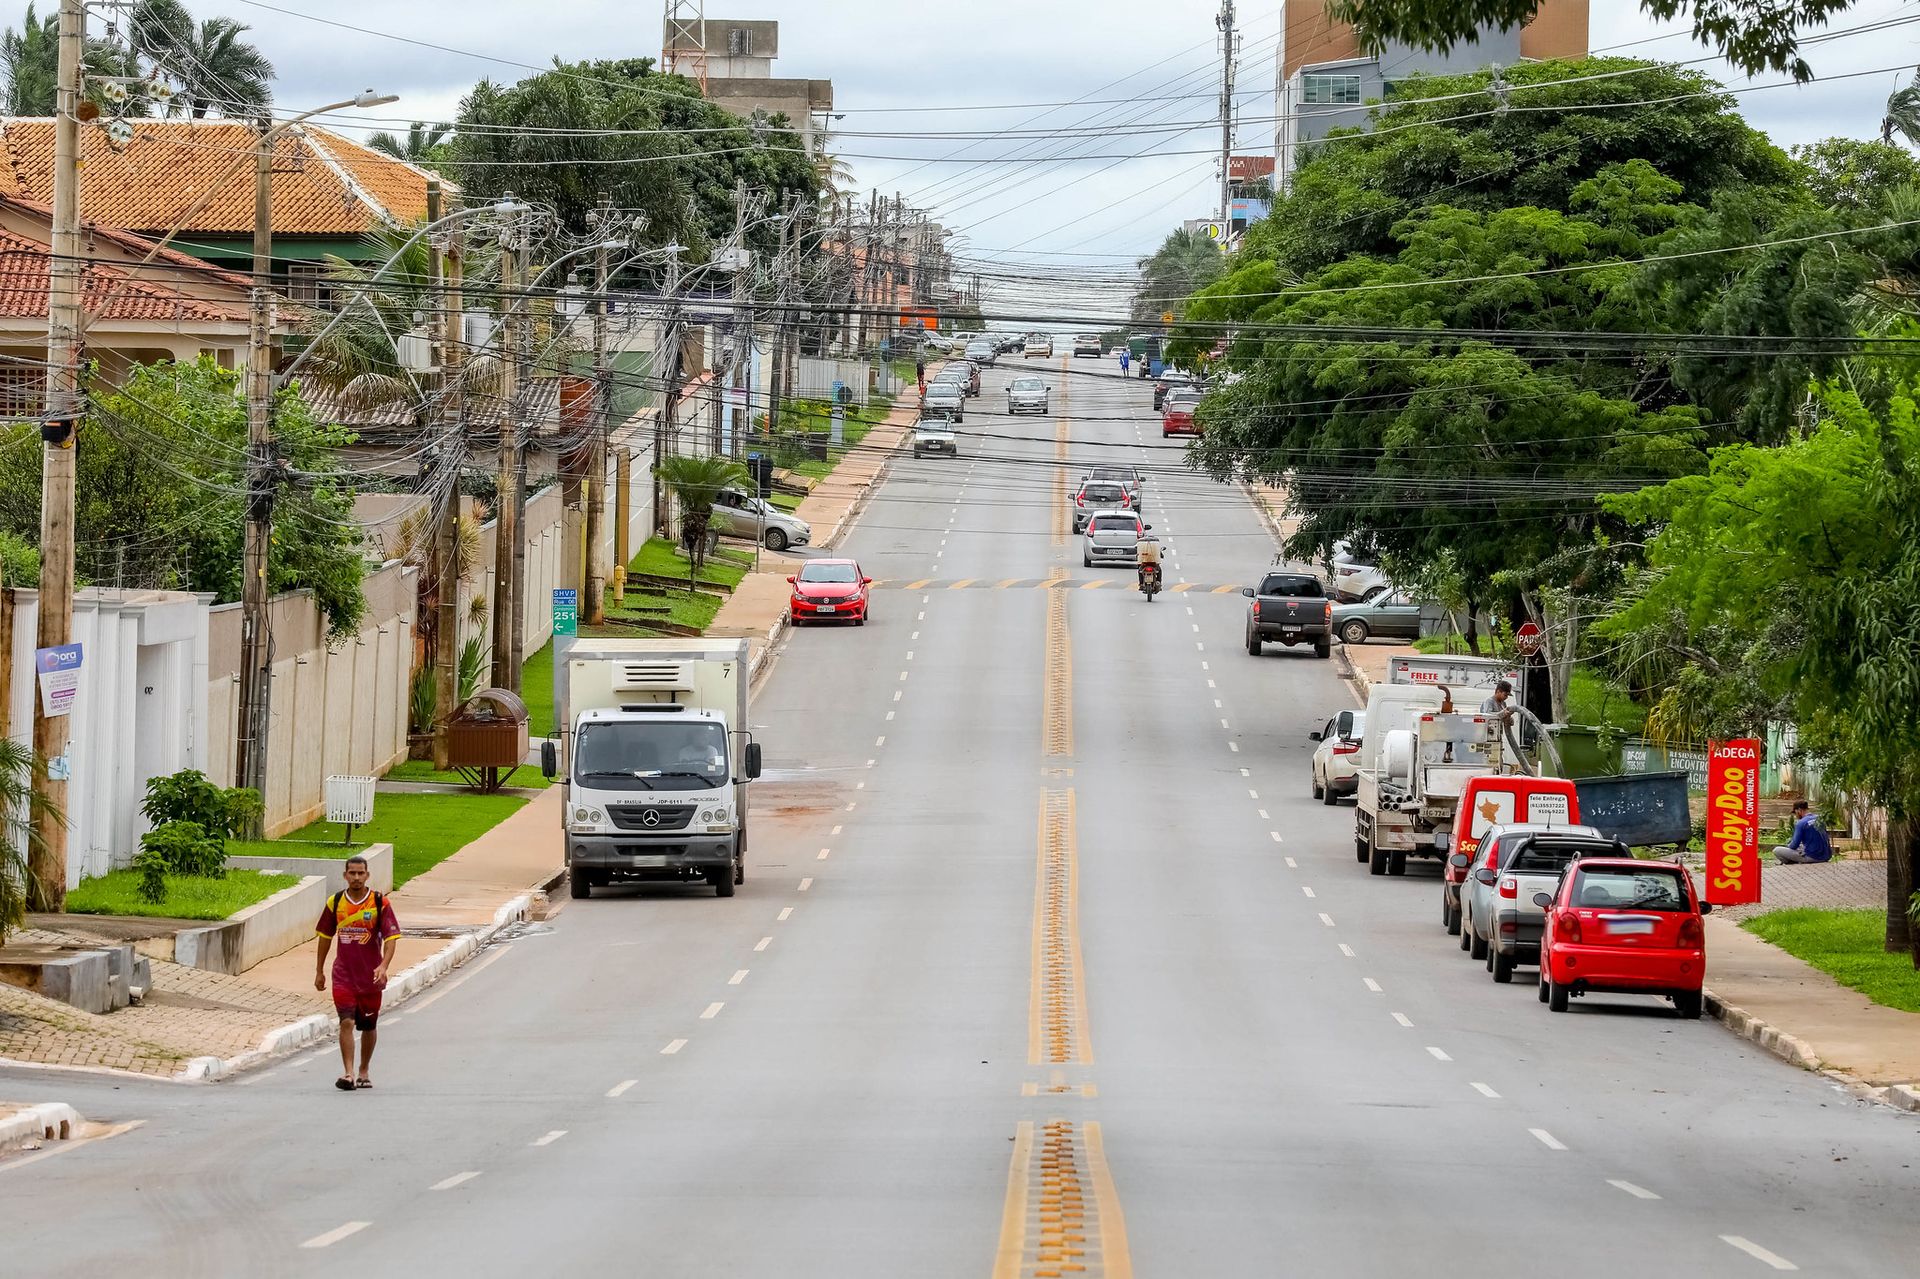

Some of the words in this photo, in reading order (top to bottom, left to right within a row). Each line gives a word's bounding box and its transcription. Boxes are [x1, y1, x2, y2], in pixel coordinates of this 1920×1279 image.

[554, 612, 575, 620] 251
[60, 651, 77, 661] ora
[723, 668, 730, 679] 7
[1410, 672, 1439, 681] FRETE
[1713, 747, 1755, 759] ADEGA
[1745, 826, 1754, 847] FRIOS
